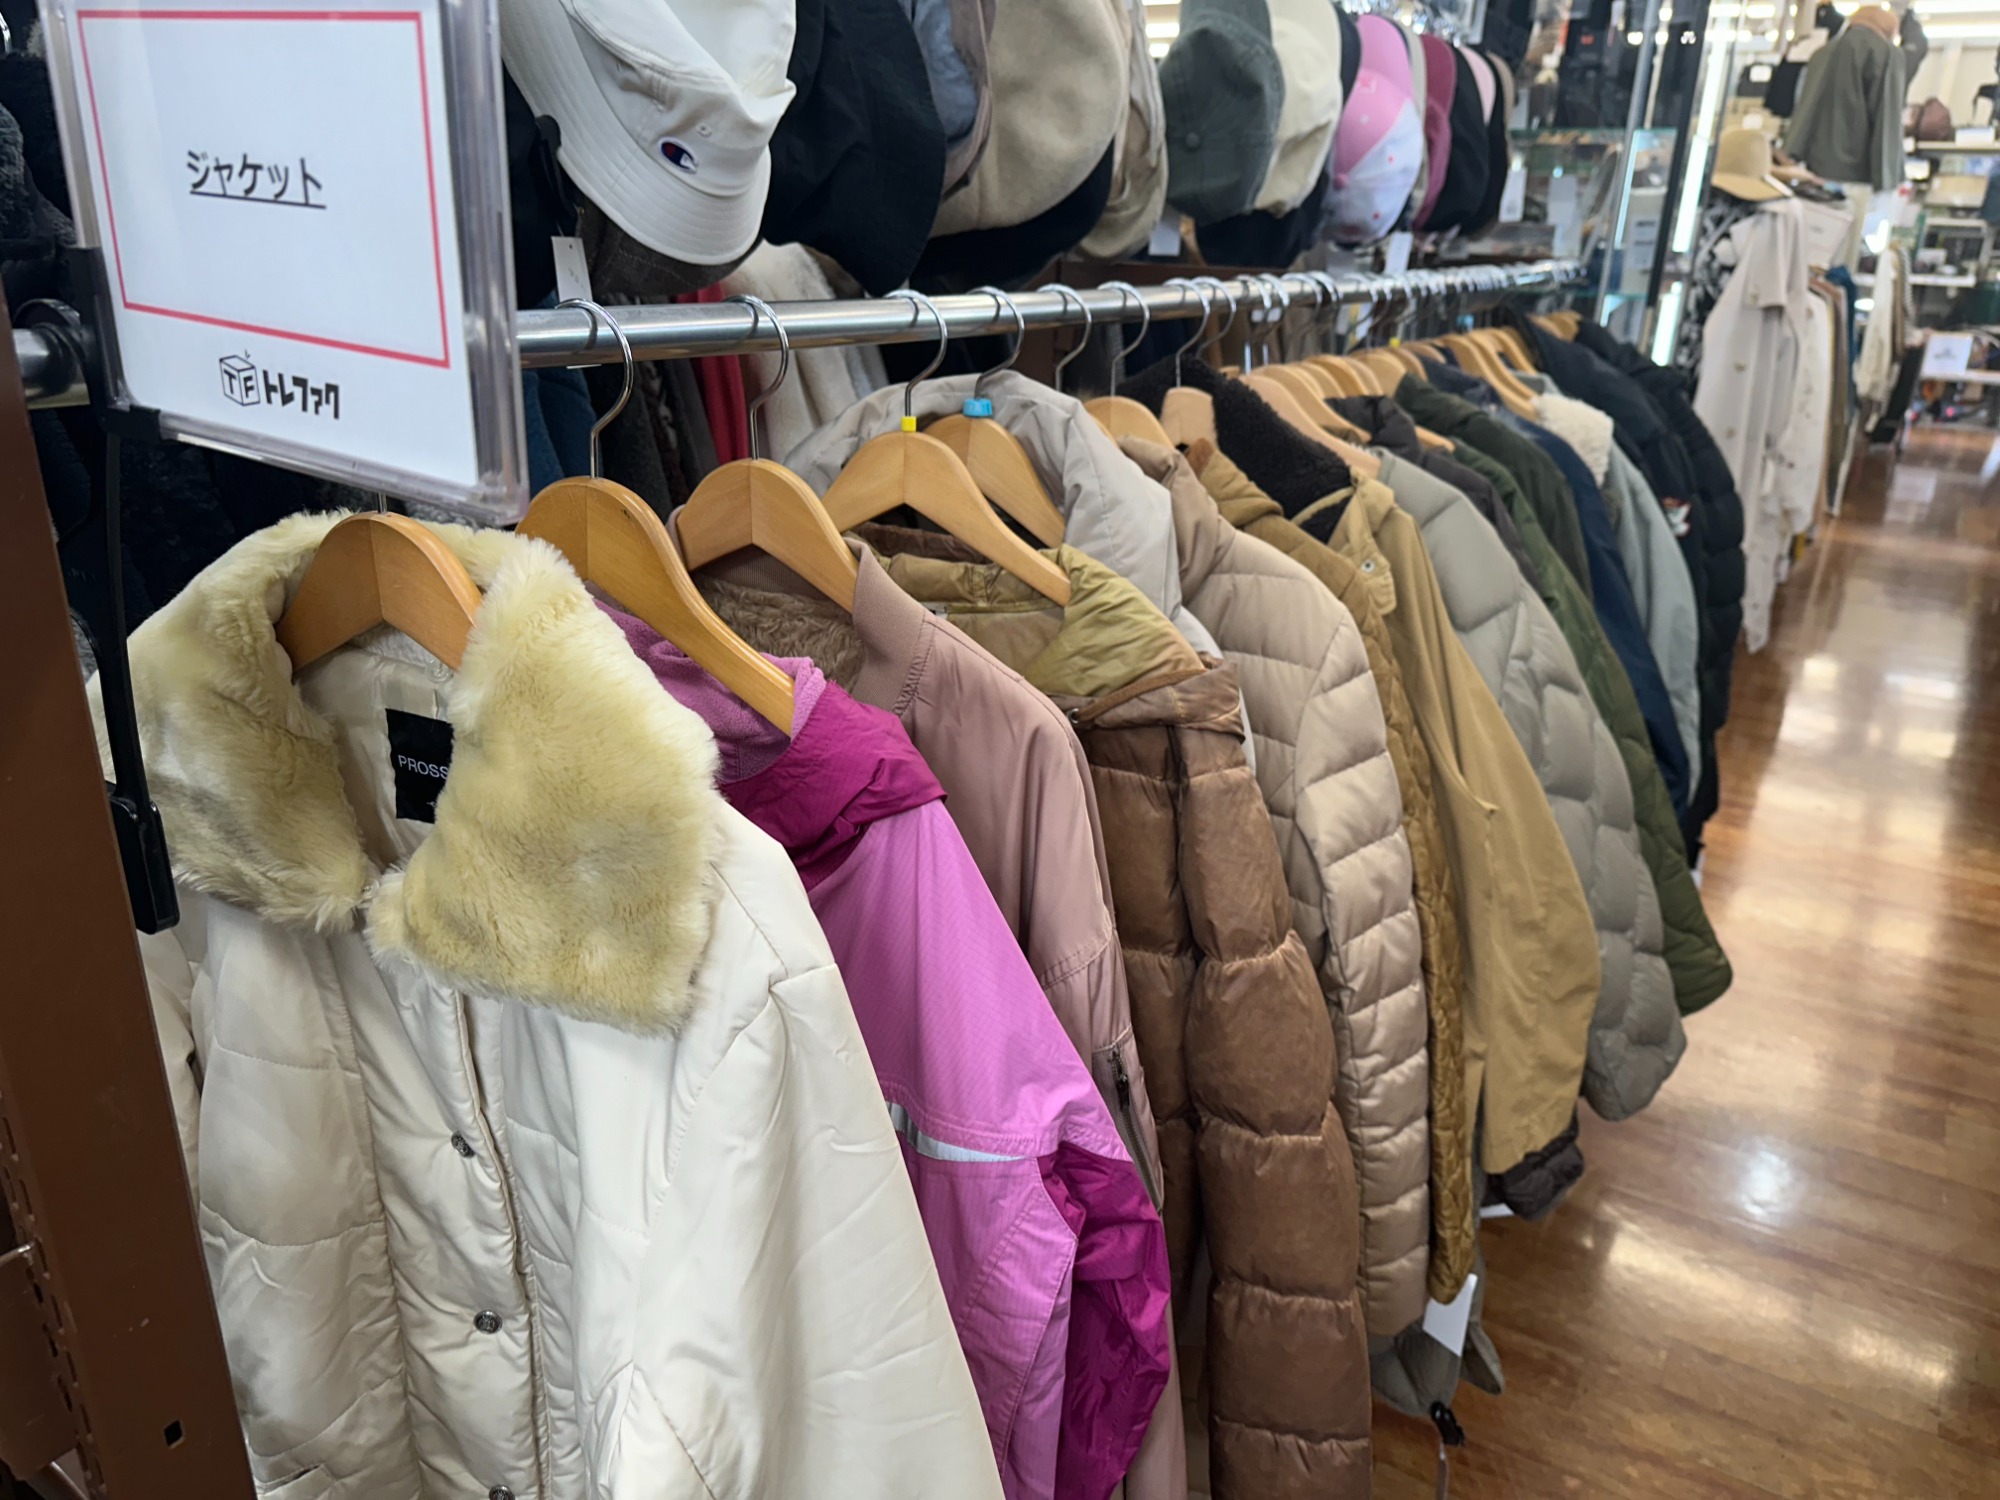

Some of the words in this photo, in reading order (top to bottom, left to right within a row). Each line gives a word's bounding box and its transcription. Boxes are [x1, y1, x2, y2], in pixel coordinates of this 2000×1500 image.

[187, 150, 323, 206] ジャケット
[262, 369, 340, 420] トレファク
